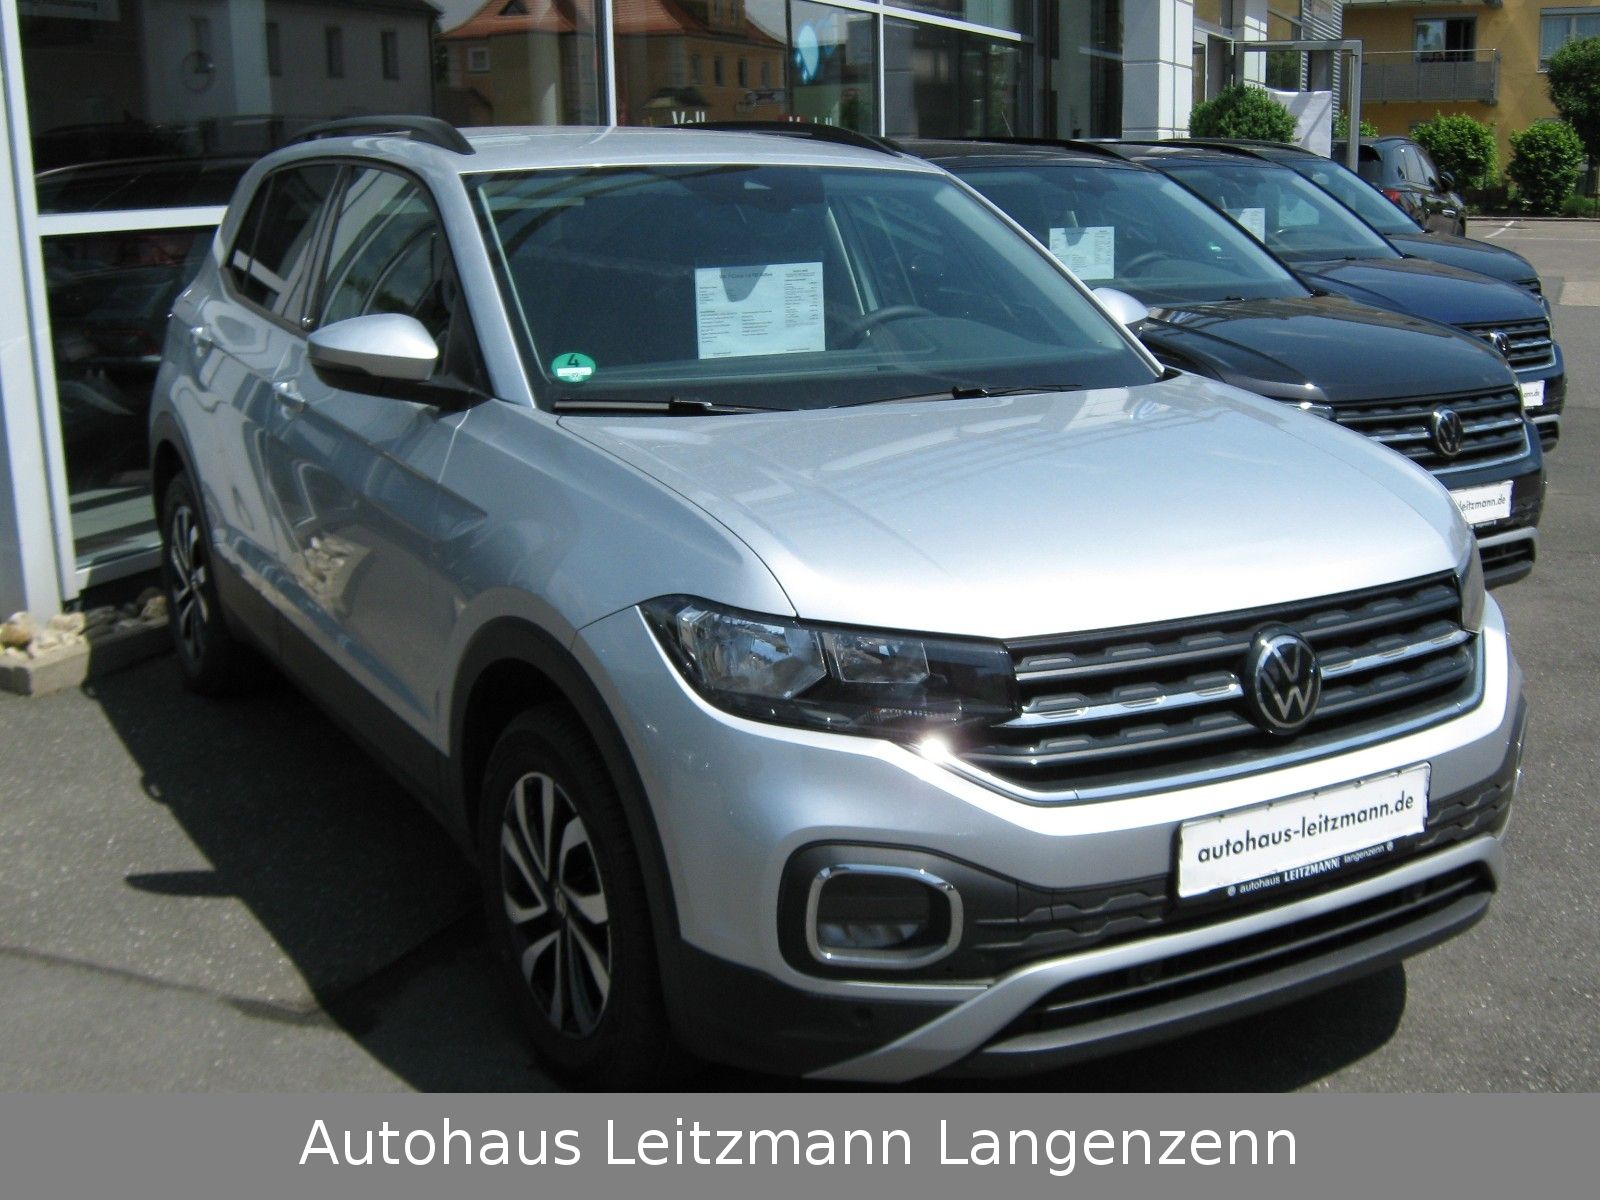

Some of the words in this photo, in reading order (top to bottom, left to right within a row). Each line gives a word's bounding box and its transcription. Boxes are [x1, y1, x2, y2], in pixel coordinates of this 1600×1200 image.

[567, 354, 580, 368] 4
[1198, 790, 1414, 863] autohaus-leitzmann.de
[1239, 875, 1281, 894] autohaus
[1284, 857, 1341, 883] LEITZMANN
[1343, 845, 1385, 864] langenzenn
